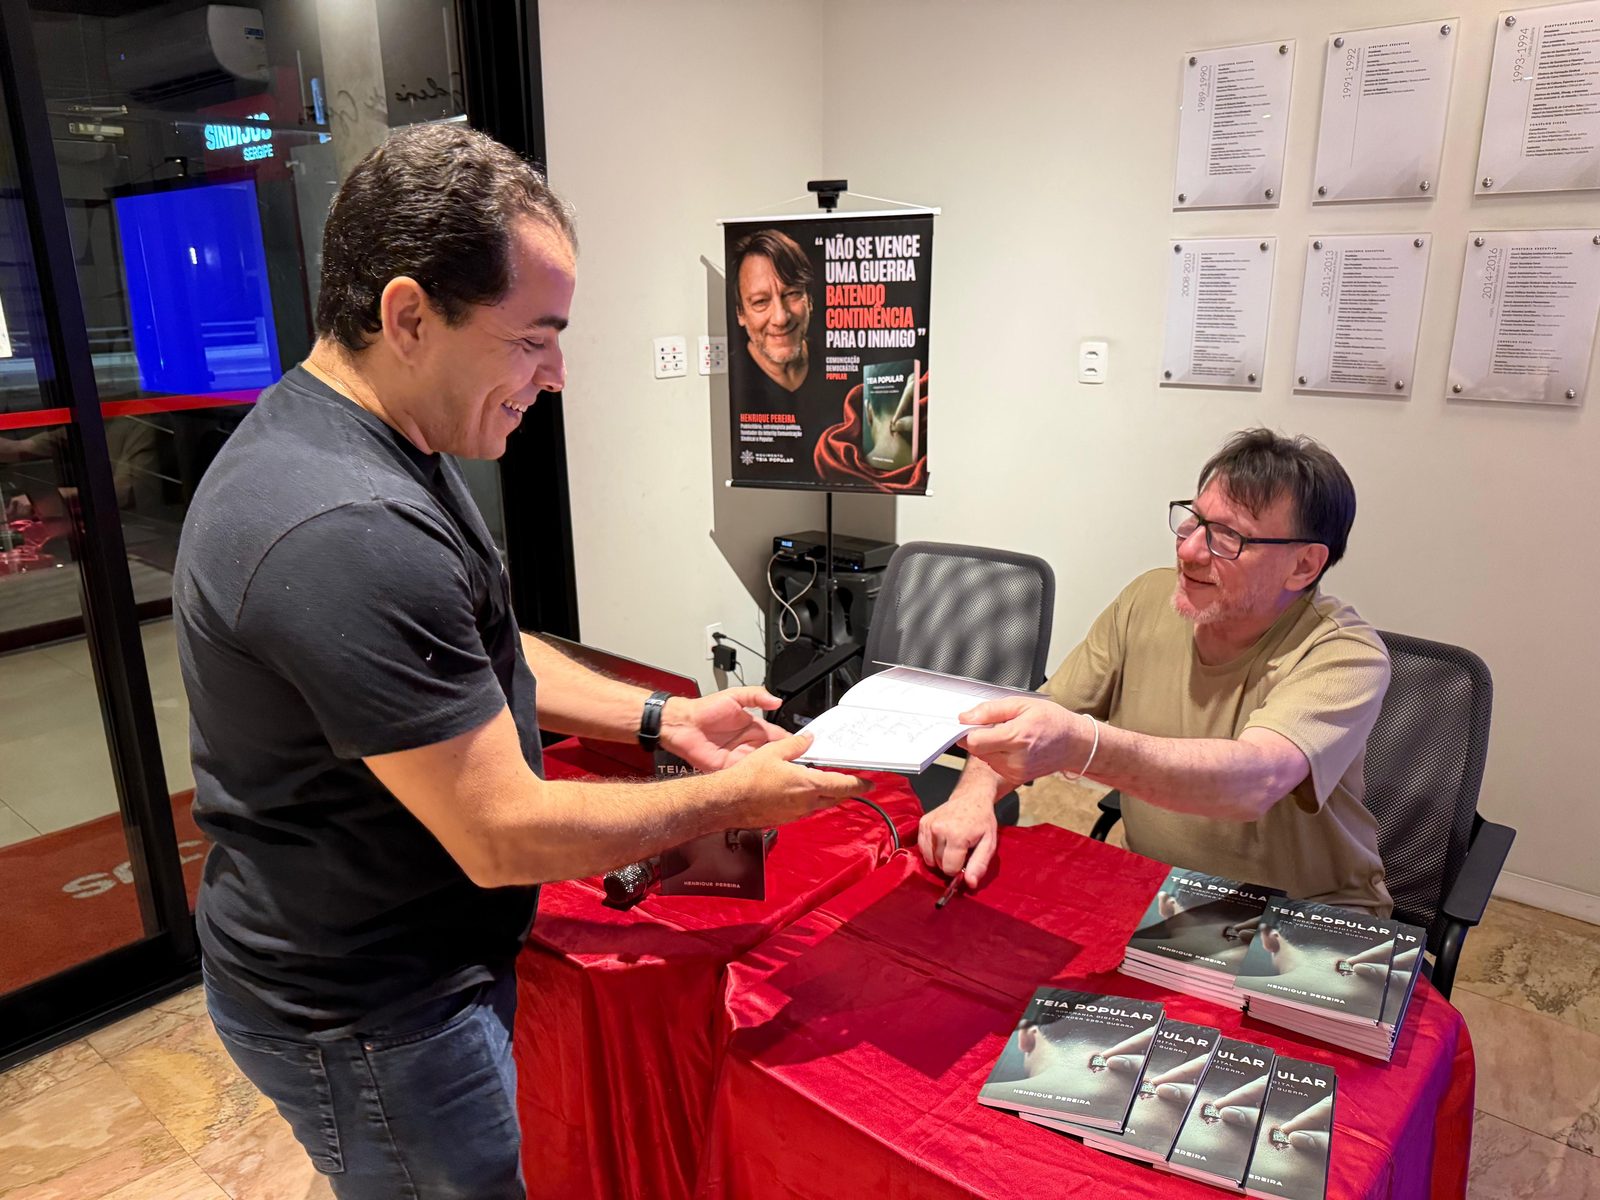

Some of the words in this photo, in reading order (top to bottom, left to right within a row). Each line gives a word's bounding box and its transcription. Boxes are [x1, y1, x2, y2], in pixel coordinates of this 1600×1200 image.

[1512, 28, 1529, 83] 1993-1994
[1342, 48, 1356, 99] 1991-1992
[1198, 65, 1208, 112] 1989-1990
[243, 143, 274, 161] SERGIPE
[856, 236, 873, 259] SE
[874, 234, 920, 258] VENCE
[825, 261, 858, 283] UMA
[860, 259, 917, 282] GUERRA
[1182, 253, 1192, 296] 2008-2010
[1320, 250, 1334, 297] 2011-2013
[1482, 248, 1498, 299] 2014-2016
[826, 284, 886, 307] BATENDO
[826, 302, 914, 329] CONTINÊNCIA
[826, 330, 856, 348] PARA
[857, 330, 866, 348] O
[826, 355, 860, 364] COMUNICAÇÃO
[826, 363, 859, 372] DEMOCRÁTICA
[878, 374, 904, 384] POPULAR
[740, 413, 770, 423] HENRIQUE
[770, 414, 796, 424] PEREIRA
[658, 765, 688, 774] TEIA
[1171, 876, 1202, 888] TEIA
[1208, 884, 1268, 902] POPULA
[1270, 906, 1304, 918] TEIA
[1310, 914, 1390, 936] POPULAR
[1157, 945, 1192, 957] HENRIQUE
[1195, 954, 1226, 966] PEREIRA
[1266, 983, 1307, 996] HENRIQUE
[1310, 993, 1346, 1004] PEREIRA
[1035, 998, 1069, 1008] TEIA
[1074, 1004, 1154, 1021] POPULAR
[1218, 1050, 1265, 1068] ULAR
[1277, 1070, 1326, 1088] ULAR
[1013, 1088, 1052, 1100] HENRIQUE
[1056, 1096, 1090, 1106] PEREIRA
[1174, 1148, 1207, 1160] EREIRA
[1248, 1174, 1282, 1186] EREIRA
